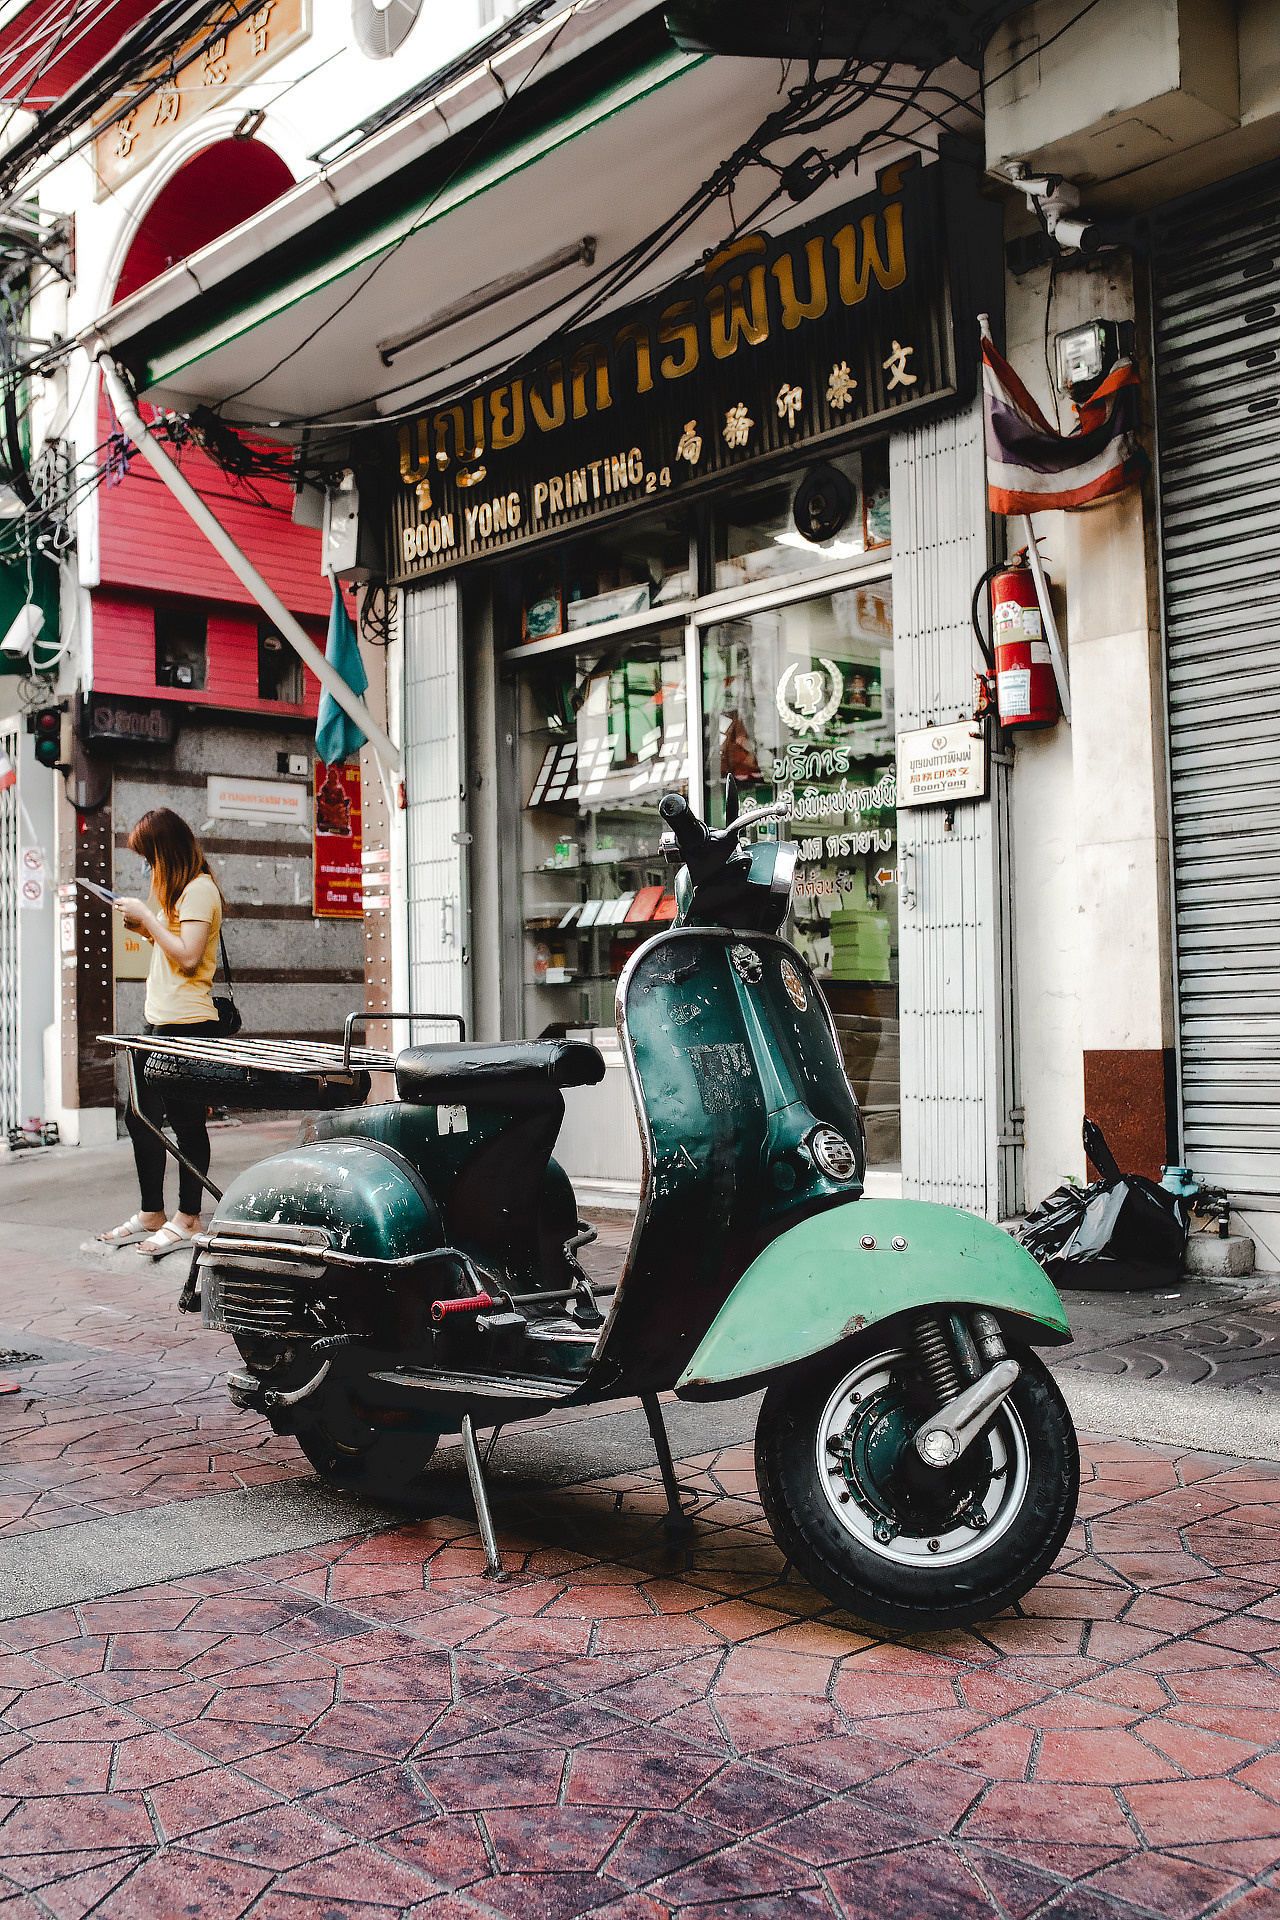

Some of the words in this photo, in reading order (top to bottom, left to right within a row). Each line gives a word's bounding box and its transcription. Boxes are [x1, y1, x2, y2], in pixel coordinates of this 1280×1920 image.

[397, 156, 916, 511] บุญยงการพิมพ์
[403, 513, 455, 562] BOON
[463, 491, 521, 541] YONG
[534, 447, 644, 518] PRINTING
[646, 466, 672, 495] 24
[772, 743, 851, 783] บริการ
[826, 828, 892, 858] ตรายาง
[795, 870, 854, 896] ดีต้อนรับ
